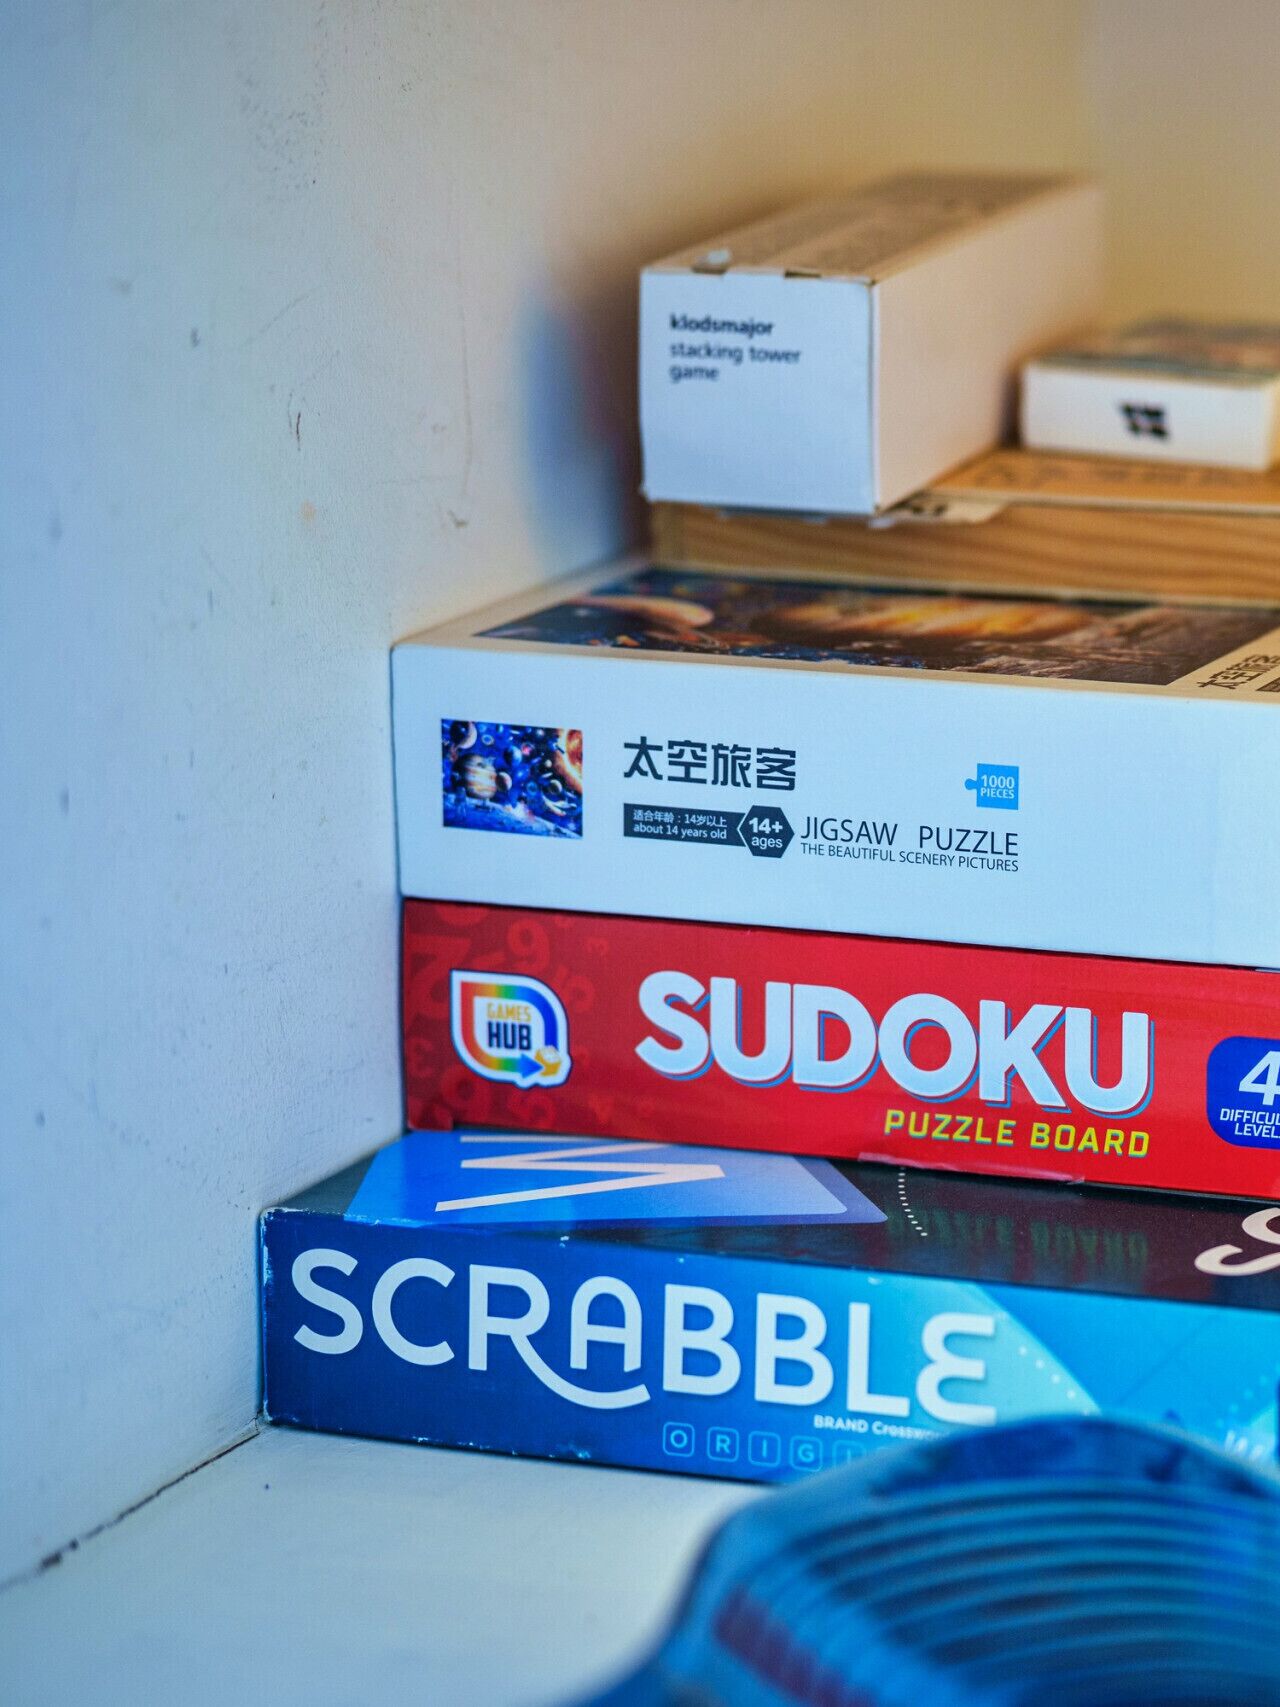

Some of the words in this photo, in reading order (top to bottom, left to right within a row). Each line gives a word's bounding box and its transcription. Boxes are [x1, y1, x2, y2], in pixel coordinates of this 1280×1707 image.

[670, 314, 773, 338] klodsmajor
[670, 343, 743, 364] stacking
[749, 347, 800, 364] tower
[669, 365, 719, 384] game
[623, 736, 796, 791] 太空旅客
[980, 774, 1015, 789] 1000
[980, 787, 1015, 799] PIECES
[633, 822, 663, 835] about
[666, 824, 679, 836] 14
[681, 827, 708, 839] years
[710, 828, 728, 840] old
[749, 817, 783, 834] 14+
[801, 816, 898, 846] JIGSAW
[919, 825, 1018, 856] PUZZLE
[751, 836, 783, 850] ages
[801, 842, 825, 856] THE
[828, 844, 895, 862] BEAUTIFUL
[899, 850, 955, 868] SCENERY
[958, 856, 1018, 872] PICTURES
[487, 1002, 532, 1023] GAMES
[487, 1021, 532, 1051] HUB
[635, 970, 1153, 1117] SUDOKU
[884, 1109, 1014, 1146] PUZZLE
[1030, 1122, 1150, 1160] BOARD
[290, 1248, 998, 1426] SCRABBLE
[813, 1414, 869, 1434] BRAND
